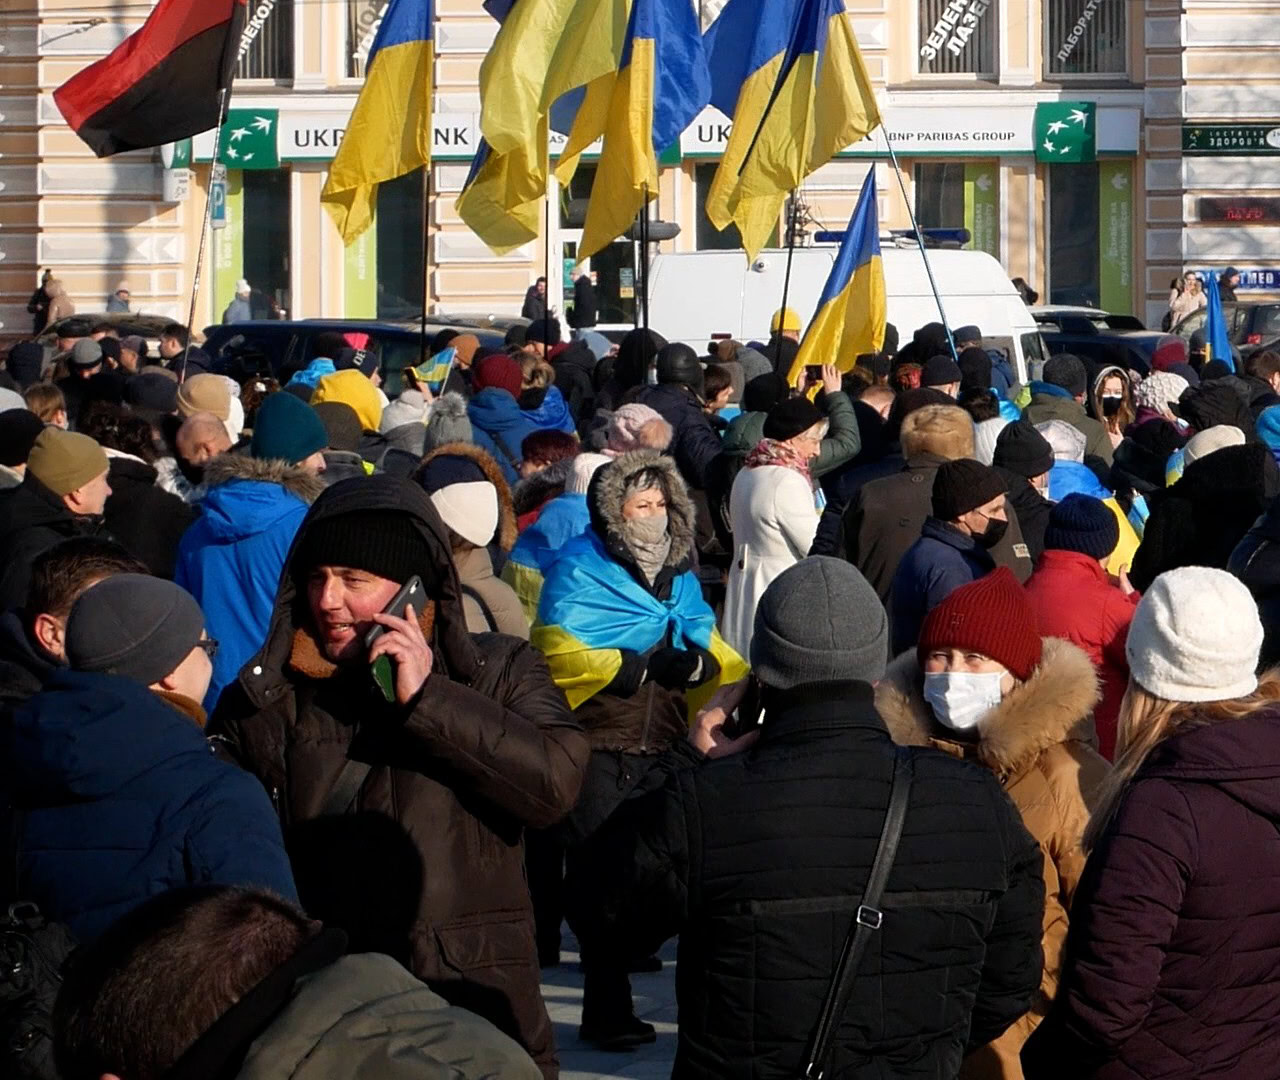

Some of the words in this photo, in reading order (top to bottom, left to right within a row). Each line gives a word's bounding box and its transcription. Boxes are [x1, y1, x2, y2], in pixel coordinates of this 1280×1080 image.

[888, 132, 914, 141] BNP
[916, 132, 969, 141] PARIBAS
[972, 132, 1016, 141] GROUP
